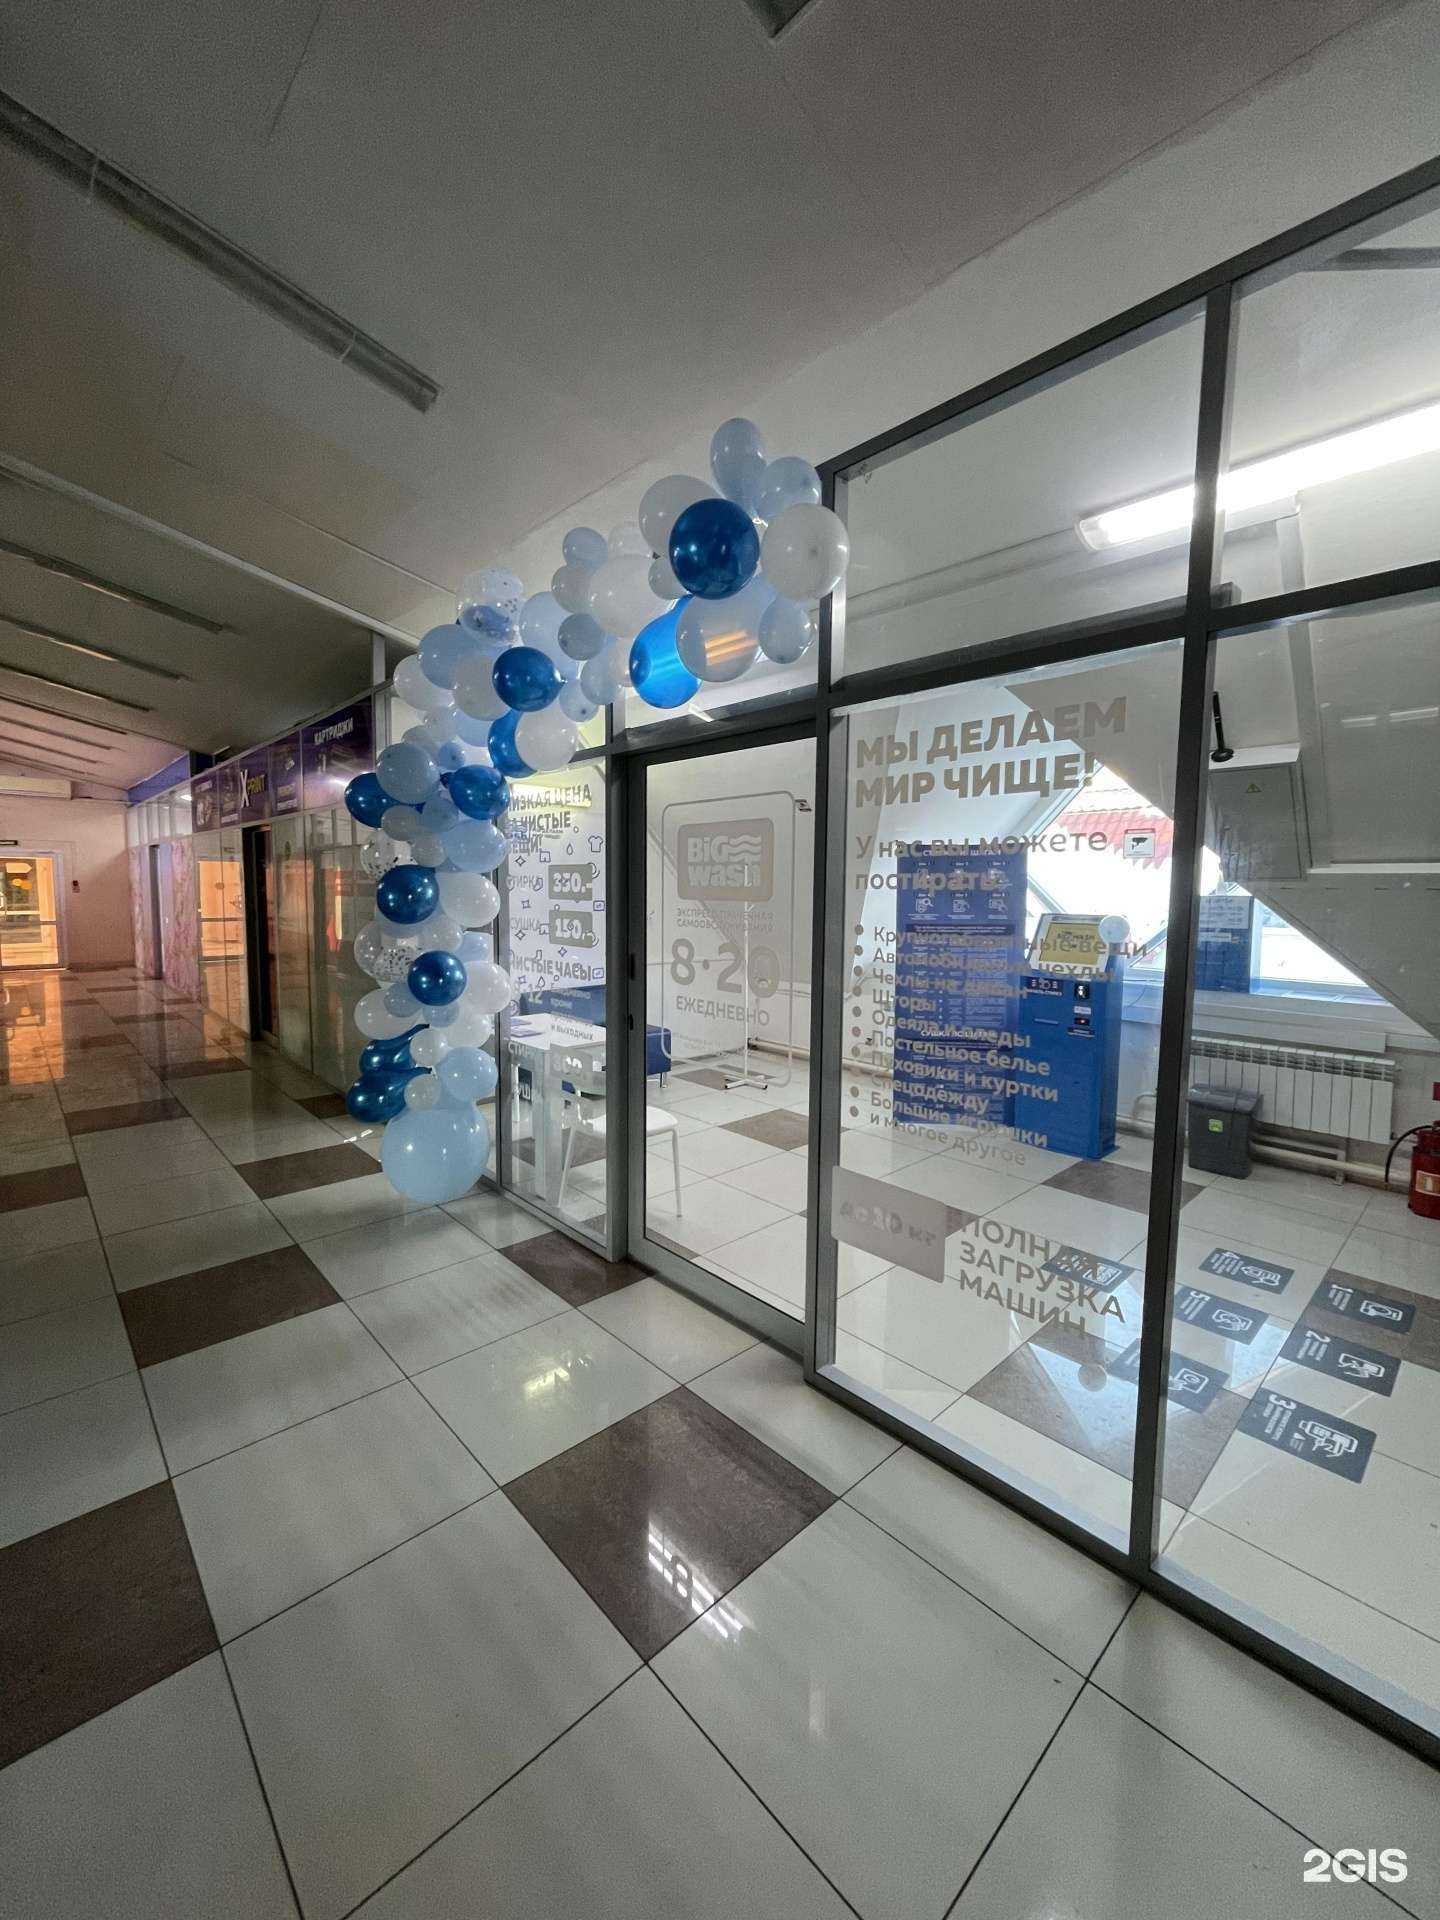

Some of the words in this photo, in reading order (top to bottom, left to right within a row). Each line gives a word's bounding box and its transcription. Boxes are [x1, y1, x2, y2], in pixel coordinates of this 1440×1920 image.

[856, 730, 919, 769] МЫ
[926, 696, 1127, 765] ДЕЛАЕМ
[855, 772, 935, 808] МИР
[943, 751, 1096, 798] ЧИЩЕ!
[855, 836, 873, 859] У
[879, 840, 923, 858] нас
[930, 839, 969, 856] вы
[980, 831, 1108, 855] можете
[855, 869, 1001, 897] постирать
[676, 995, 771, 1027] ЕЖЕДНЕВНО
[871, 1031, 982, 1064] Постельное
[986, 1049, 1050, 1076] белье
[964, 1073, 977, 1087] и
[982, 1075, 1059, 1101] куртки
[870, 1091, 950, 1122] Большие
[955, 1113, 1048, 1148] игрушки
[870, 1113, 880, 1126] и
[884, 1117, 949, 1144] многое
[951, 1137, 1027, 1166] другое
[959, 1240, 1126, 1324] ЗАГРУЗКА
